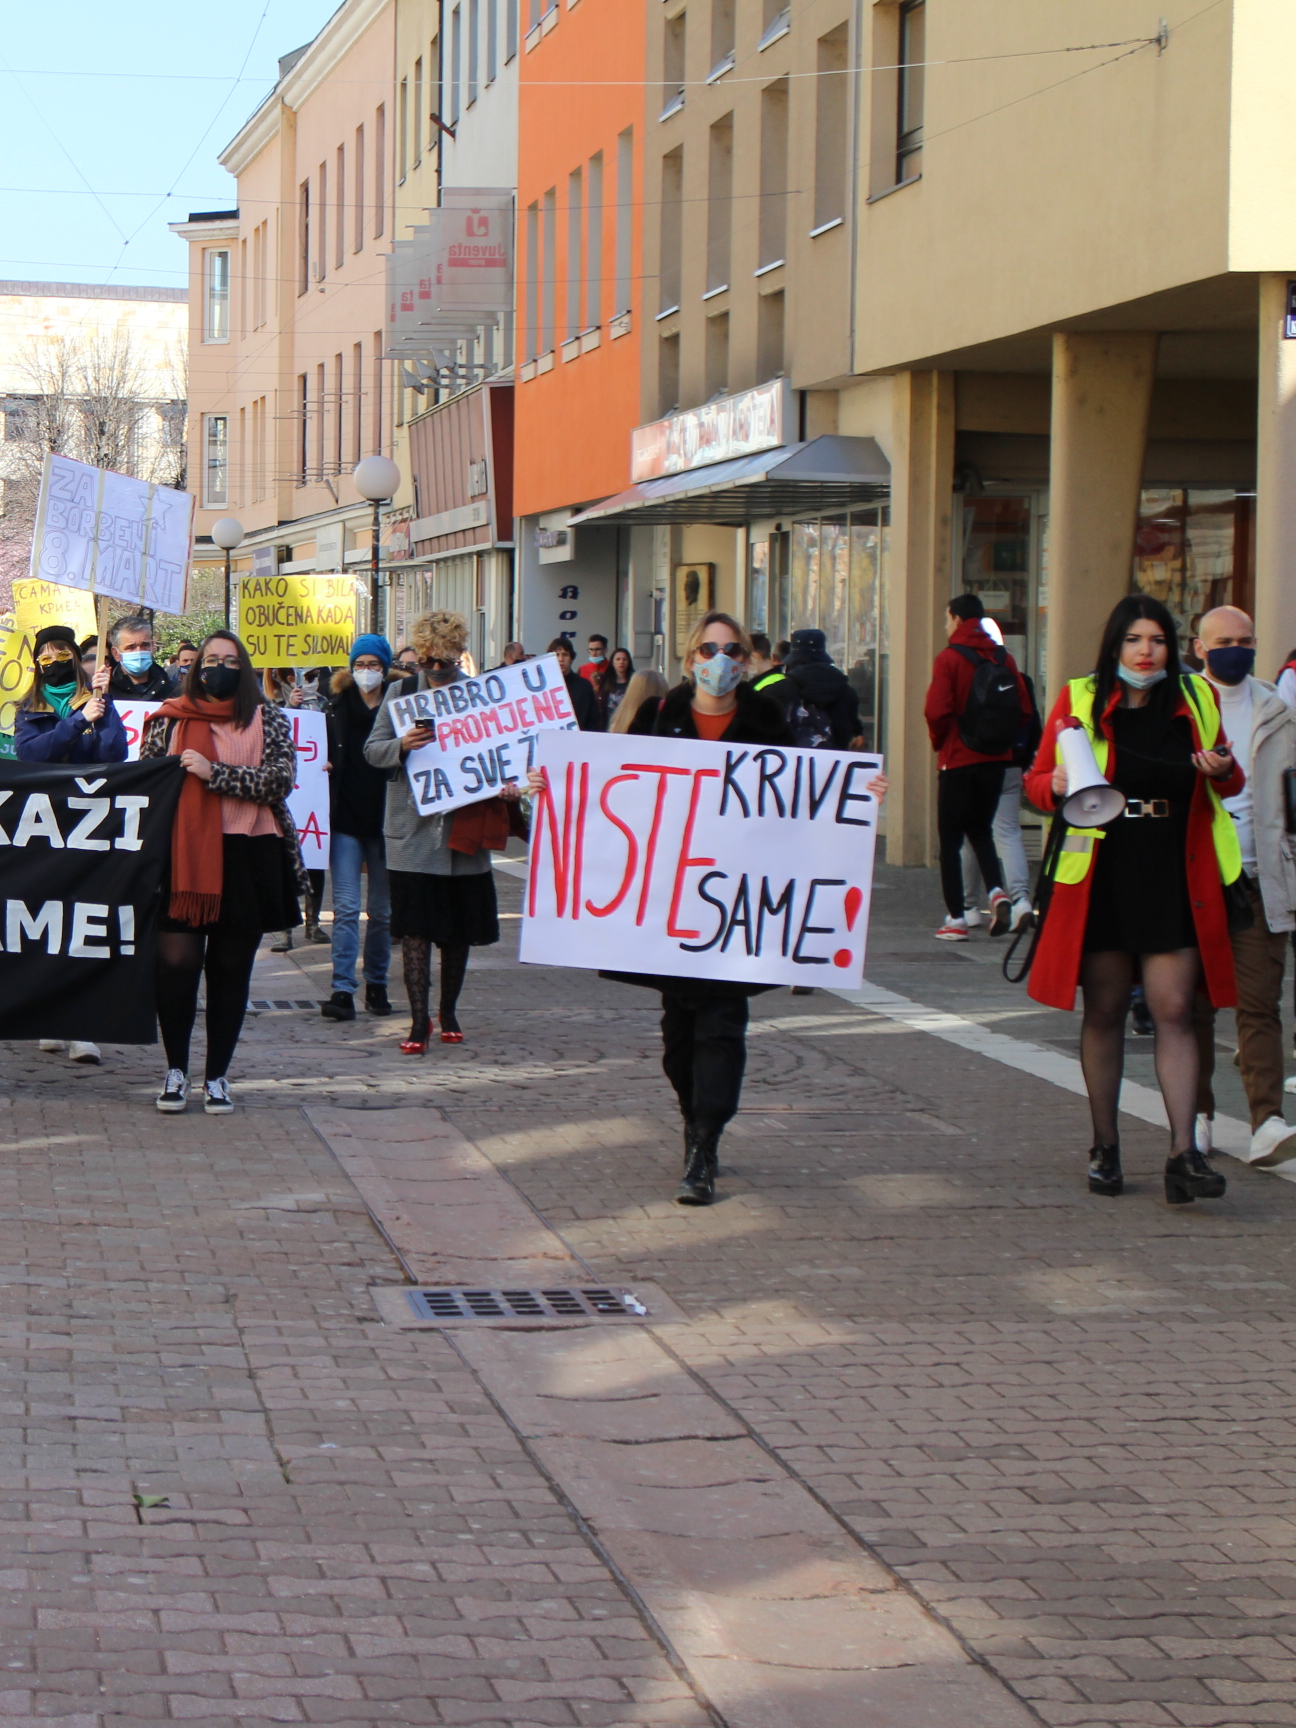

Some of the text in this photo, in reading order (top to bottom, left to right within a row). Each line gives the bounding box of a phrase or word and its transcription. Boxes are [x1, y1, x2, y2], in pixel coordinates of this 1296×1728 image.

[49, 466, 95, 509] ZA
[39, 530, 183, 607] 8. MART
[242, 577, 356, 599] KAKO SI BILA
[245, 601, 355, 627] OBUČENA KADA
[246, 634, 267, 657] SU
[273, 634, 297, 657] TE
[394, 664, 547, 728] HRABRO U
[437, 686, 572, 752] PROMJENE
[413, 767, 454, 805] ZA
[460, 742, 519, 794] SVE
[529, 749, 879, 939] NISTE KRIVE
[679, 871, 863, 969] SAME!
